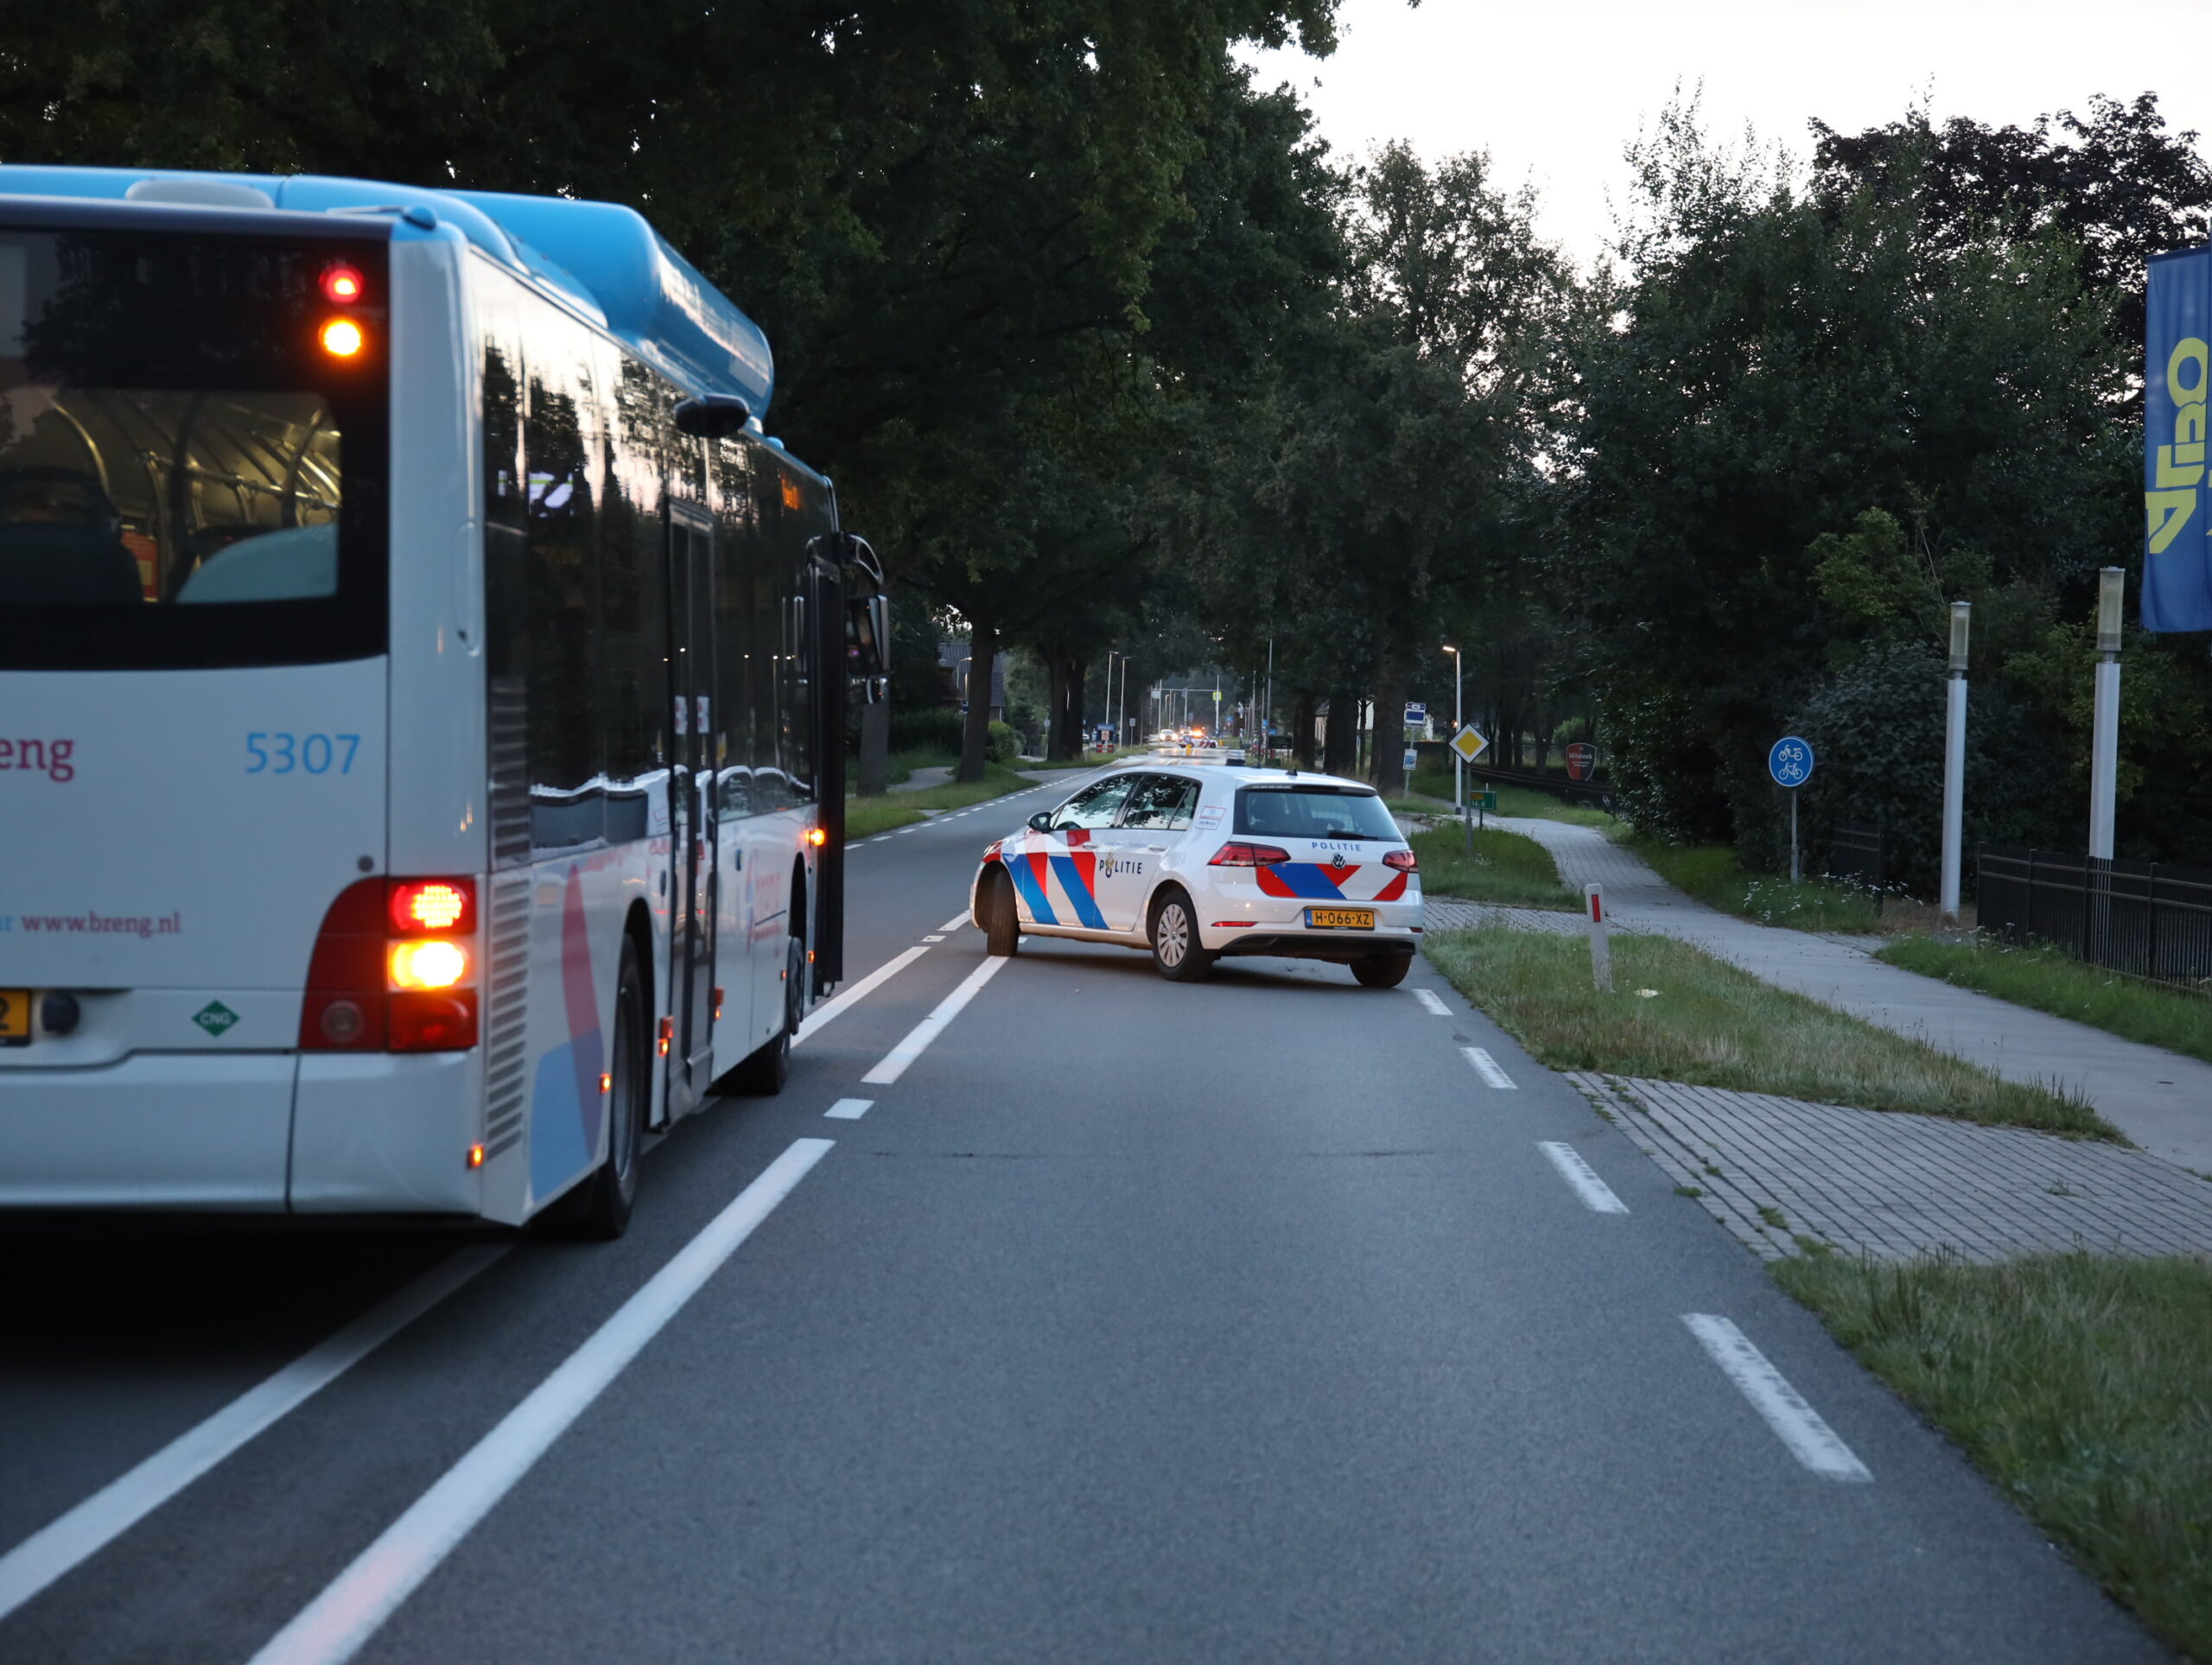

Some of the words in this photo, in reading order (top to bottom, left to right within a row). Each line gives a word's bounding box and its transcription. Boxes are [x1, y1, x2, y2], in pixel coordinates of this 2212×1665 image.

[246, 733, 361, 773] 5307
[1312, 842, 1361, 851] POLITIE
[1099, 859, 1142, 878] POLITIE
[22, 911, 181, 938] www.breng.nl
[1315, 912, 1370, 925] H-066-XZ
[200, 1012, 232, 1026] CNG
